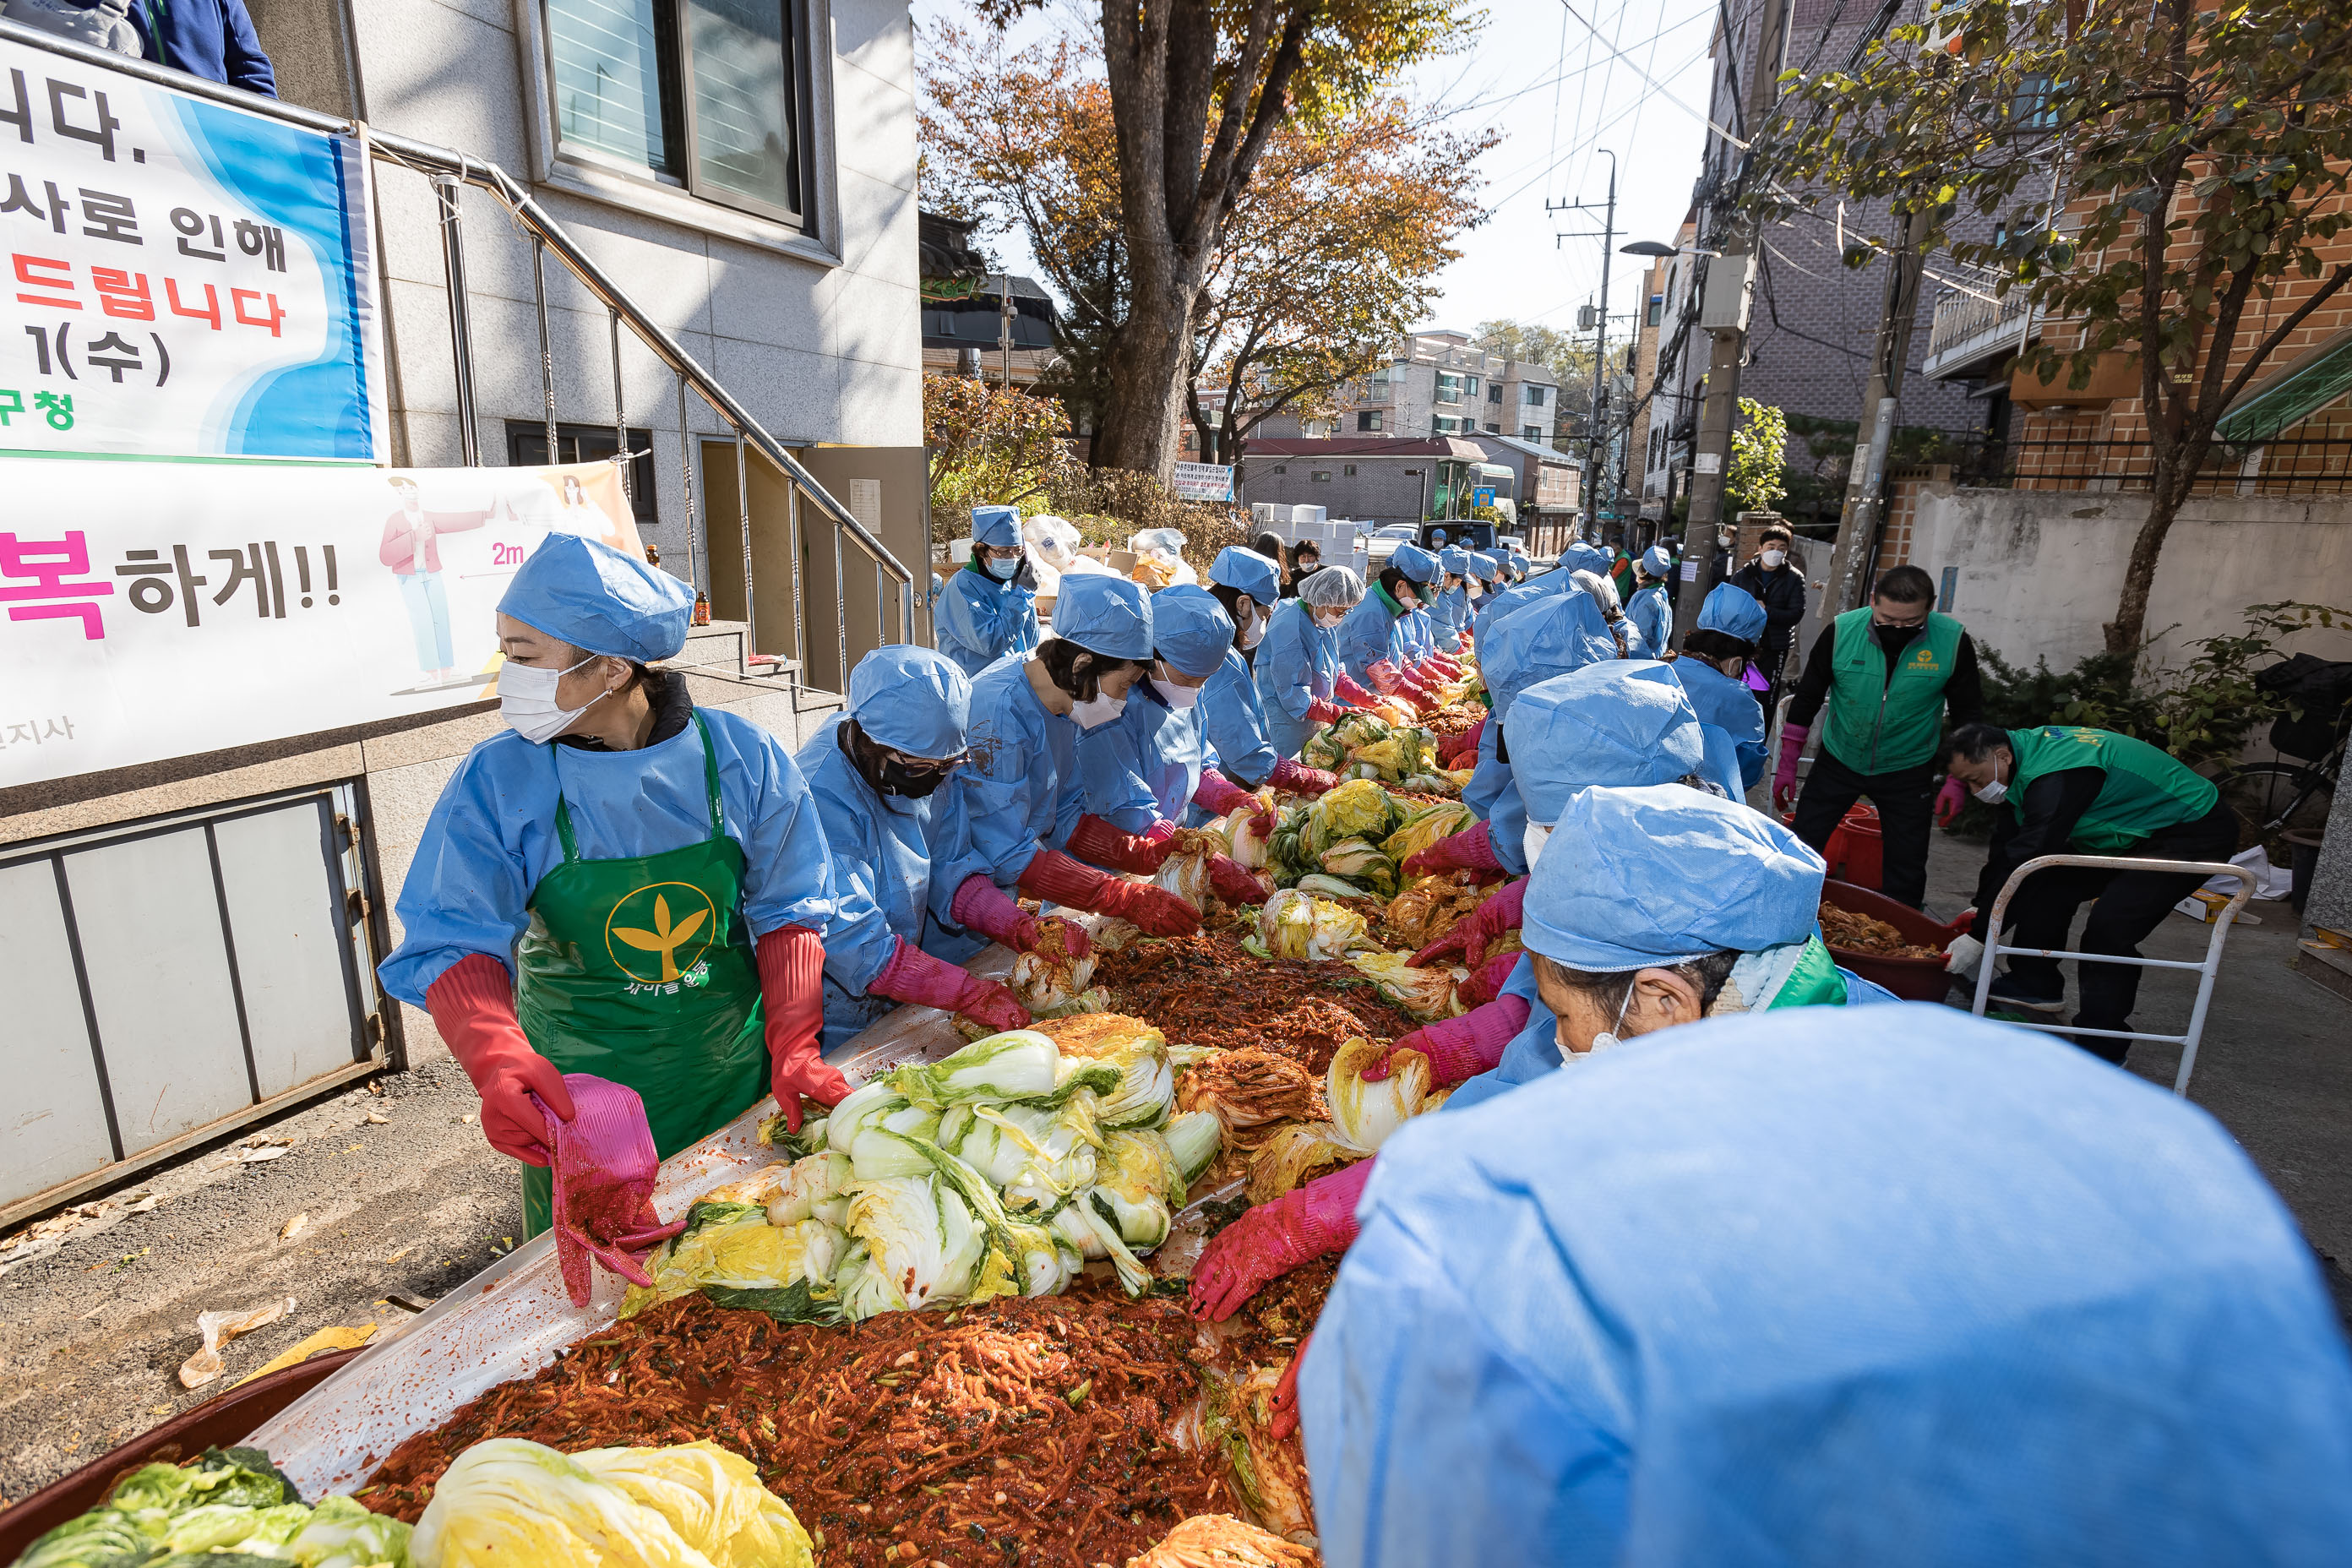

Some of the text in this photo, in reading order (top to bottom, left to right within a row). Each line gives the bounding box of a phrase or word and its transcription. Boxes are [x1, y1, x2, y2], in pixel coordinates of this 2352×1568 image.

[0, 173, 286, 274] 사로 인해
[11, 253, 287, 338] 드립니다
[24, 321, 172, 388] 1(수)
[0, 389, 74, 432] 구청
[493, 542, 524, 565] 2m
